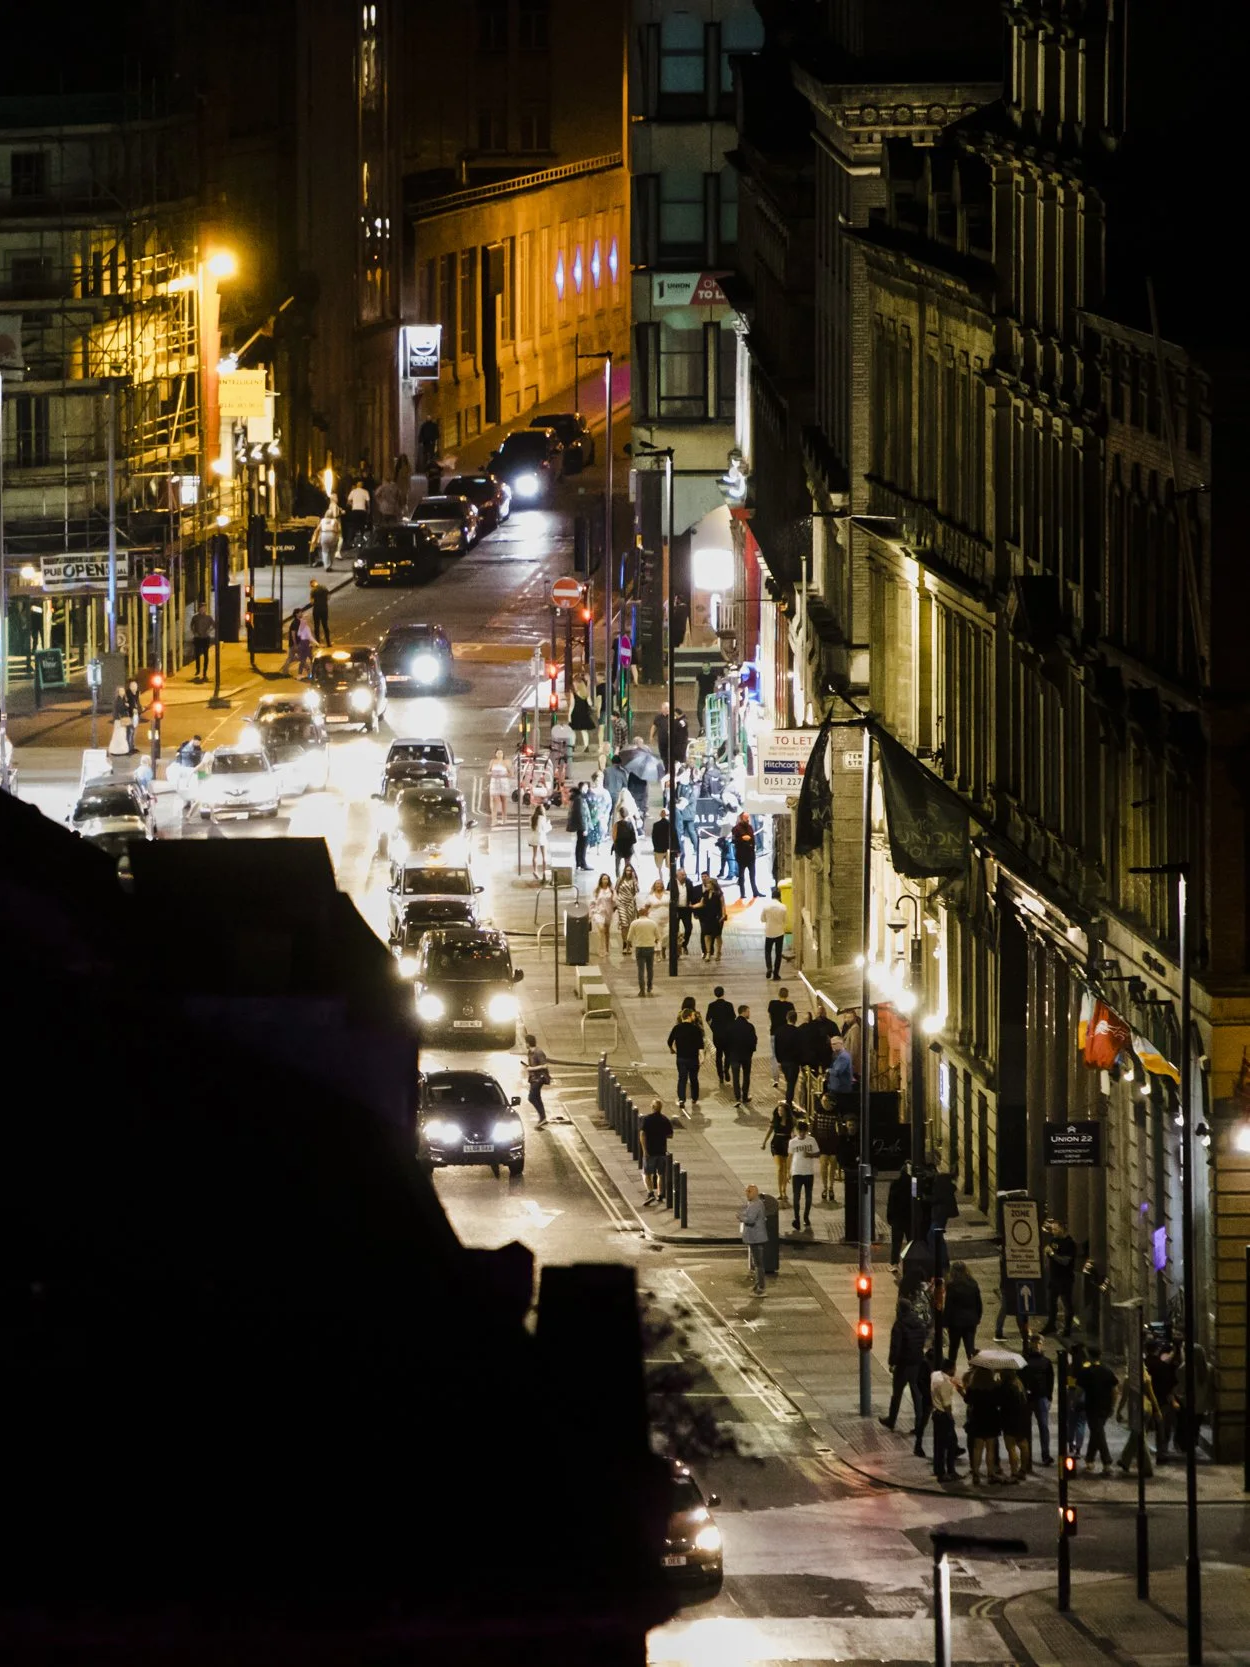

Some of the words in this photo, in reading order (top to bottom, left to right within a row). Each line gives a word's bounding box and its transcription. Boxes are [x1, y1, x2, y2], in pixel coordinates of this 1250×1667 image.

[698, 290, 713, 299] TO
[43, 567, 62, 577] PUB
[63, 563, 105, 578] OPEN
[774, 736, 789, 745] TO
[793, 736, 813, 745] LET
[764, 760, 798, 769] Hitchcock
[764, 777, 783, 785] 0151
[787, 777, 801, 785] 227
[1050, 1135, 1079, 1143] UNION
[1081, 1135, 1093, 1143] 22
[1011, 1210, 1030, 1218] ZONE
